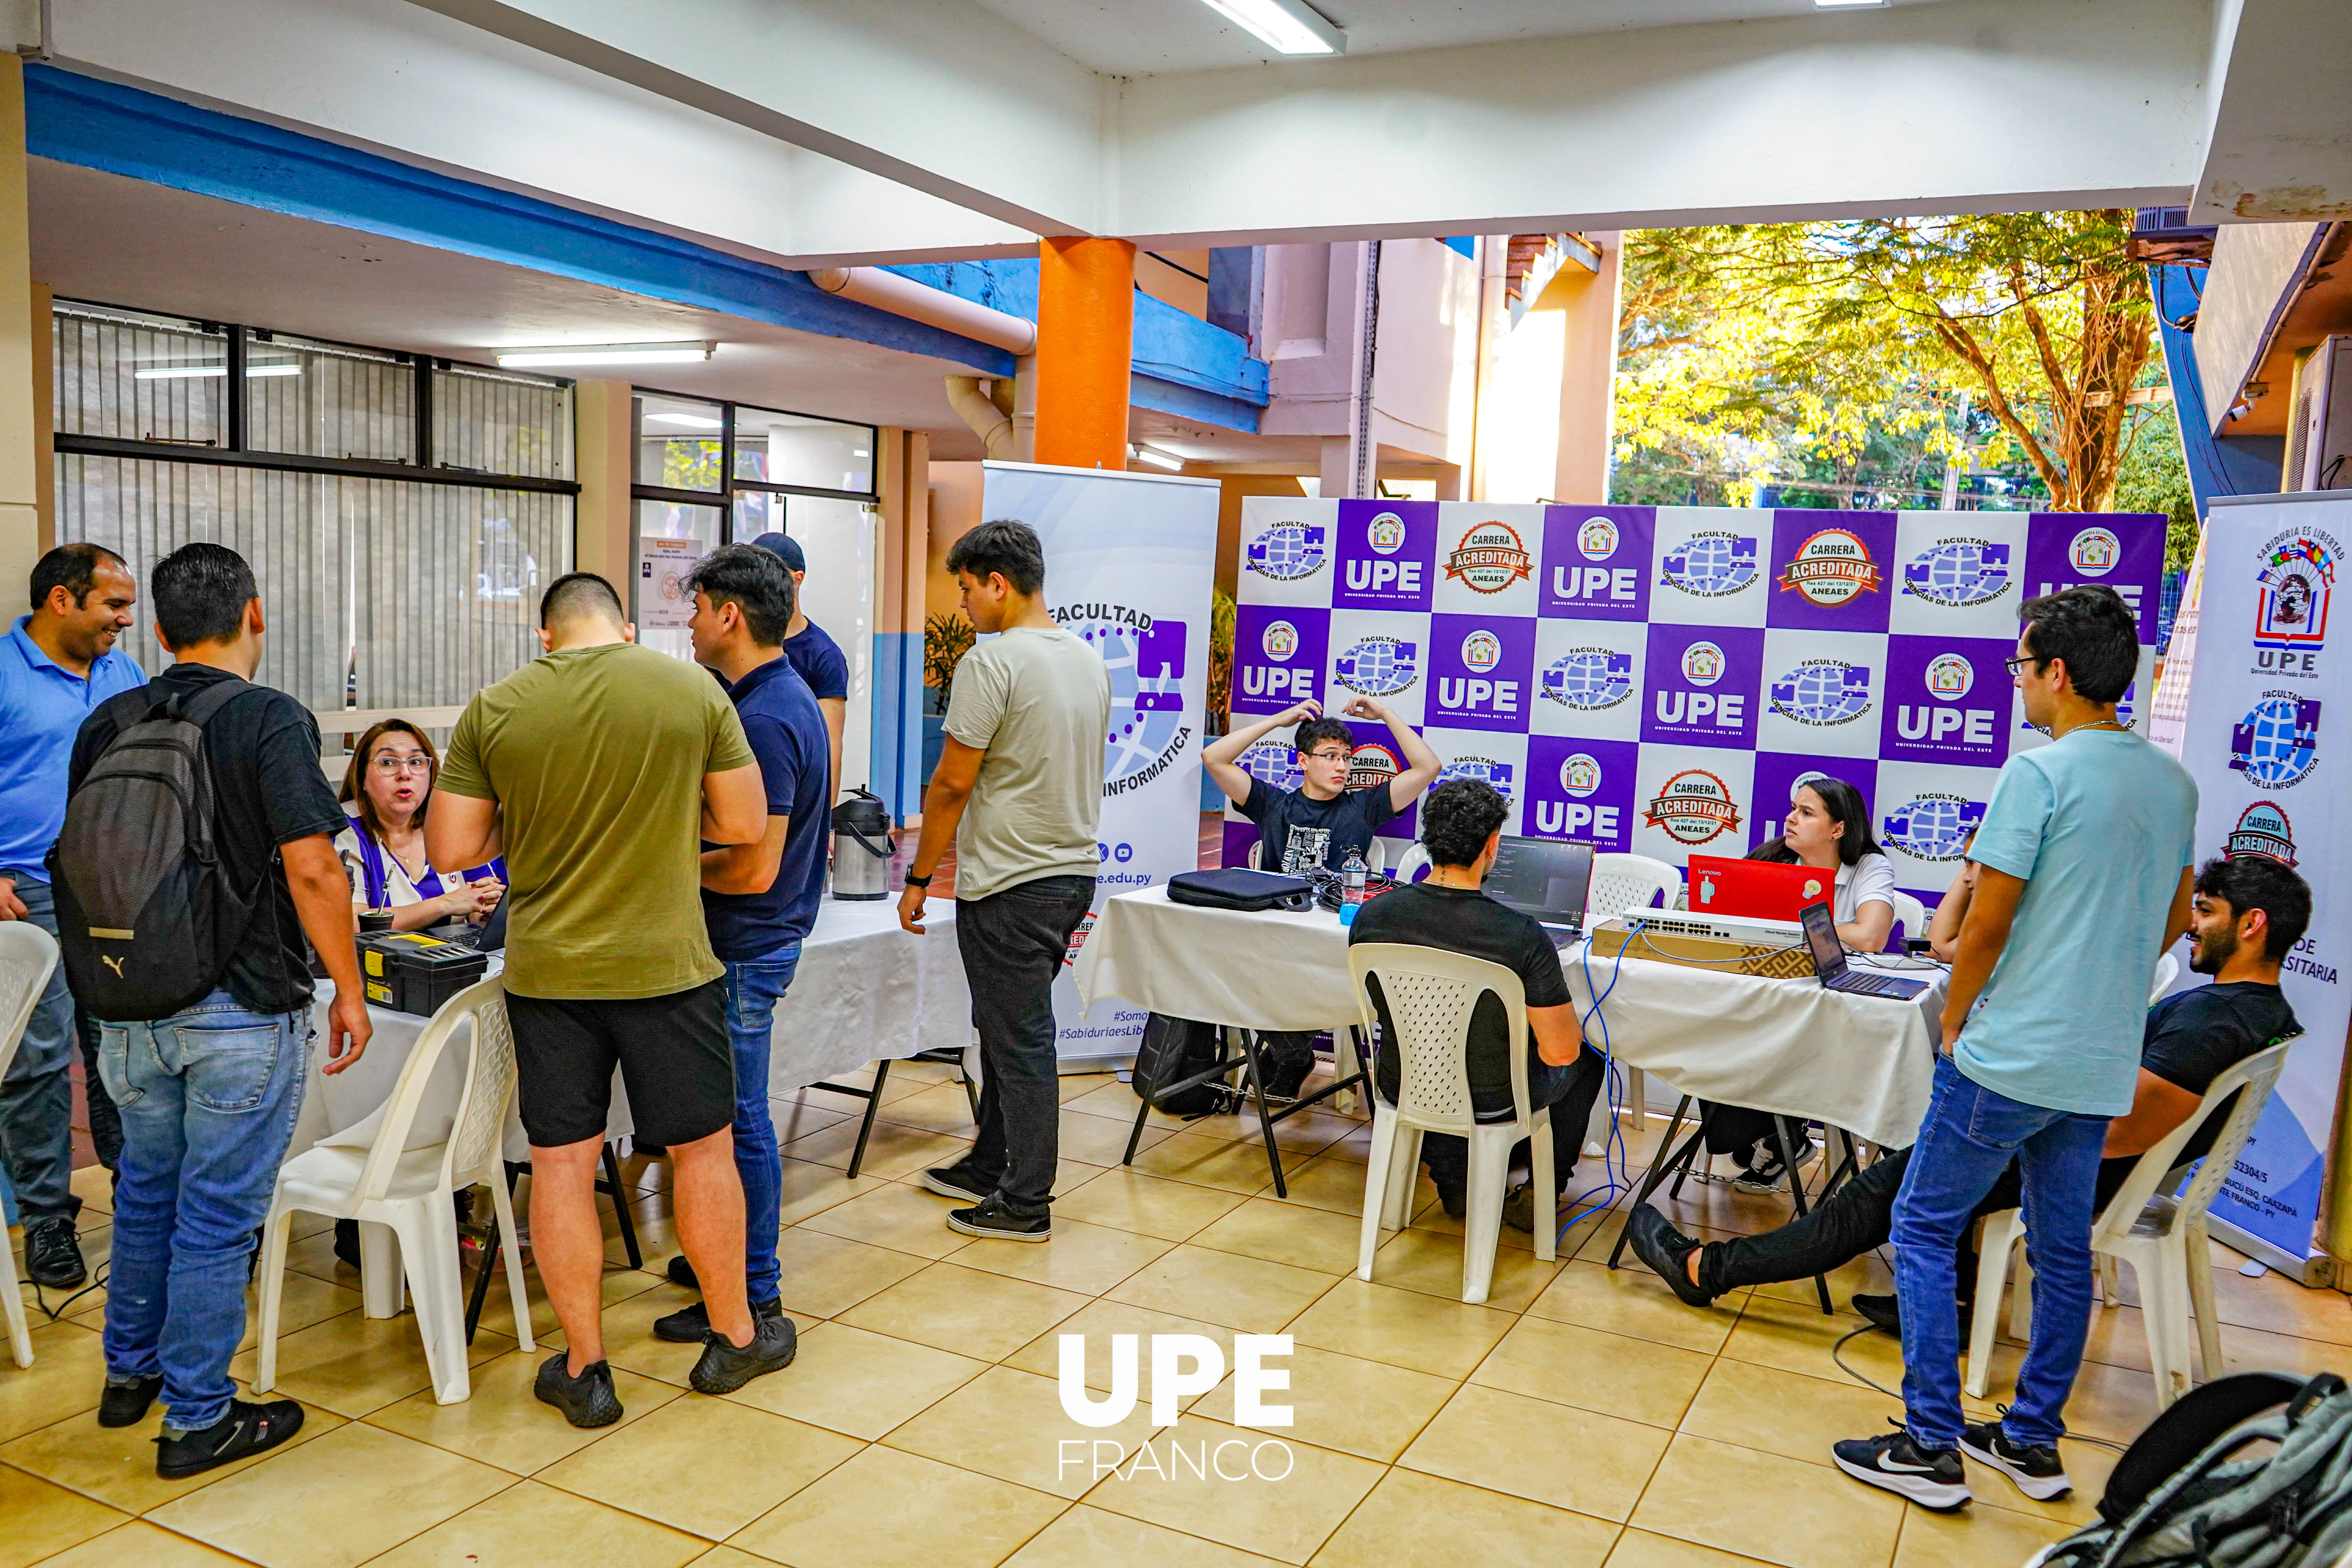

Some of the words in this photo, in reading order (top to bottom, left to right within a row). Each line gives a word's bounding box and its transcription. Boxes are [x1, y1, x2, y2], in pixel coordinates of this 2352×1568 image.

[1472, 535, 1510, 544] CARRERA
[1692, 531, 1738, 540] FACULTAD
[1937, 537, 1989, 547] FACULTAD
[2257, 528, 2299, 561] SABIDURIA
[2303, 526, 2311, 536] ES
[2314, 528, 2345, 560] LIBERTAD
[1811, 545, 1855, 554] CARRERA
[1248, 557, 1269, 578] CIENCIAS
[1289, 559, 1327, 581] INFORMATICA
[1455, 552, 1524, 567] ACREDITADA
[1346, 559, 1422, 592] UPE
[1792, 562, 1871, 579] ACREDITADA
[1553, 566, 1637, 601] UPE
[1663, 570, 1689, 594] CIENCIAS
[1714, 573, 1759, 597] INFORMATICA
[1905, 578, 1935, 603] CIENCIAS
[1962, 581, 2012, 607] INFORMATICA
[1048, 604, 1152, 630] FACULTAD
[1361, 636, 1400, 645] FACULTAD
[1570, 647, 1614, 656] FACULTAD
[2258, 651, 2316, 671] UPE
[1802, 659, 1851, 669] FACULTAD
[2251, 668, 2277, 676] Universidad
[1243, 666, 1314, 698] UPE
[1336, 671, 1358, 693] CIENCIAS
[1379, 675, 1418, 697] INFORMATICA
[1439, 677, 1519, 712] UPE
[1543, 683, 1567, 706] CIENCIAS
[1591, 688, 1634, 710] INFORMATICA
[2262, 690, 2303, 701] FACULTAD
[1656, 690, 1744, 728] UPE
[1771, 697, 1798, 723] CIENCIAS
[1824, 702, 1872, 727] INFORMATICA
[1897, 704, 1994, 744] UPE
[1256, 740, 1293, 750] FACULTAD
[1103, 726, 1192, 797] INFORMATICA
[1352, 757, 1389, 768] CARRERA
[1454, 757, 1496, 766] FACULTAD
[1345, 773, 1392, 785] CREDITA
[2252, 777, 2261, 787] DE
[2262, 780, 2271, 789] LA
[2273, 757, 2319, 790] INFORMATICA
[1675, 784, 1716, 795] CARRERA
[1916, 793, 1967, 804] FACULTAD
[1536, 800, 1619, 838] UPE
[1657, 801, 1731, 819] ACREDITADA
[2247, 815, 2281, 832] CARRERA
[1884, 830, 1913, 857] CIENCIAS
[2232, 837, 2290, 862] ACREDITADA
[1097, 873, 1151, 886] e.edu.py
[2282, 956, 2337, 984] SITARIA
[1114, 1012, 1148, 1022] #Somo
[2245, 1186, 2260, 1200] ESQ.
[2232, 1192, 2259, 1212] FRANCO
[2266, 1209, 2275, 1218] PY
